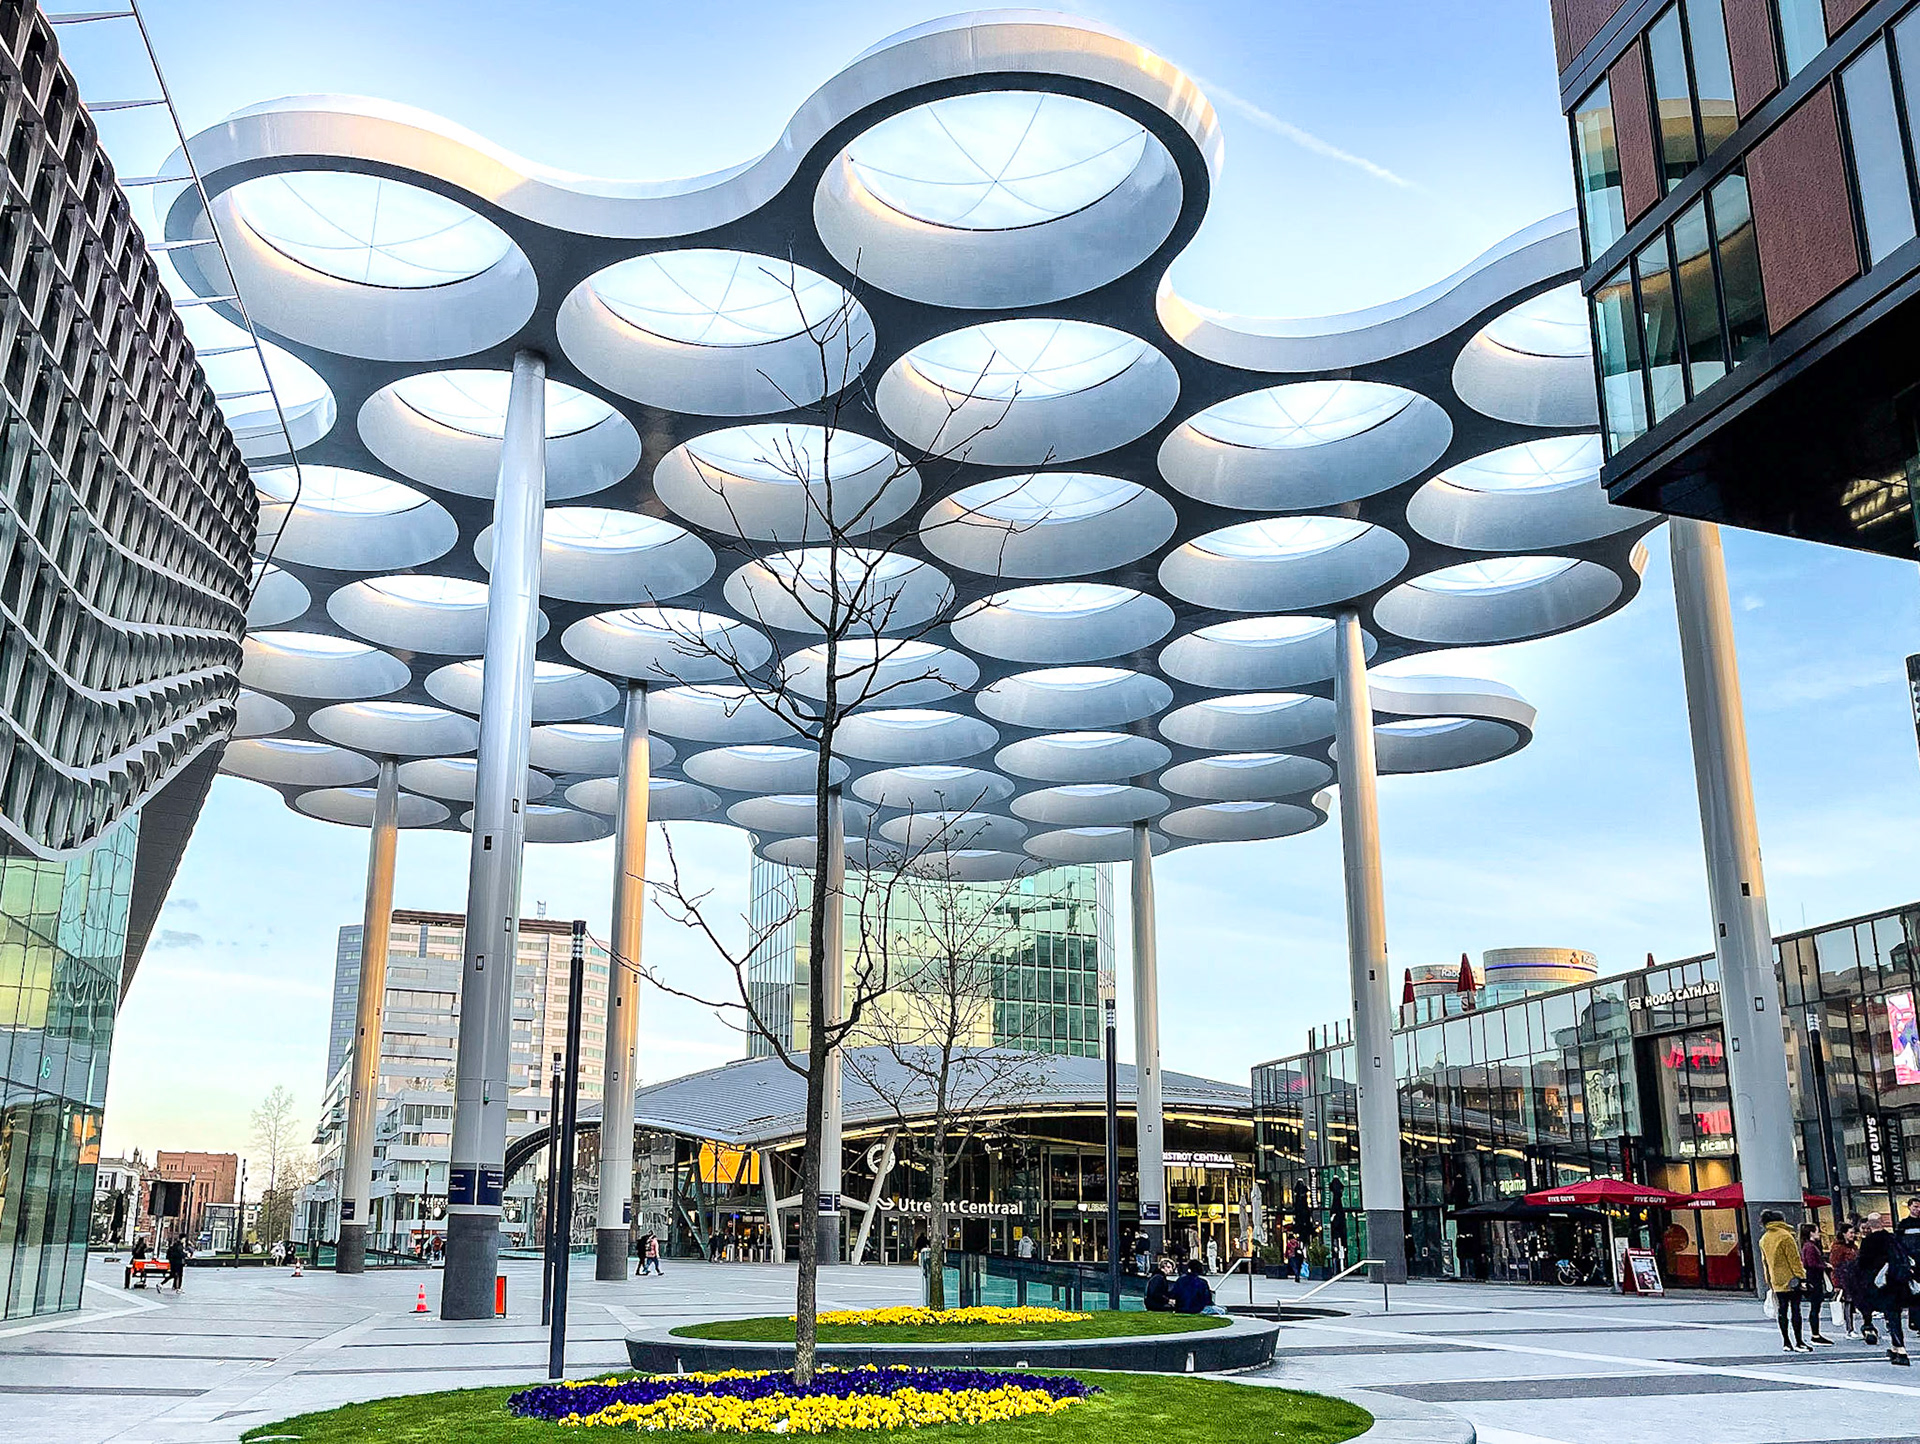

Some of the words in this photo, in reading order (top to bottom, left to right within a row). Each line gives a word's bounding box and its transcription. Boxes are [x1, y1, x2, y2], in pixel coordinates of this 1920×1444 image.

[1644, 991, 1675, 1007] HOOG
[1866, 1117, 1880, 1152] GUYS
[1679, 1141, 1728, 1154] Amrican
[1193, 1153, 1235, 1163] CENTRAAL
[1872, 1154, 1884, 1183] FIVE
[898, 1198, 956, 1213] Utreht
[959, 1199, 1023, 1215] Centraal
